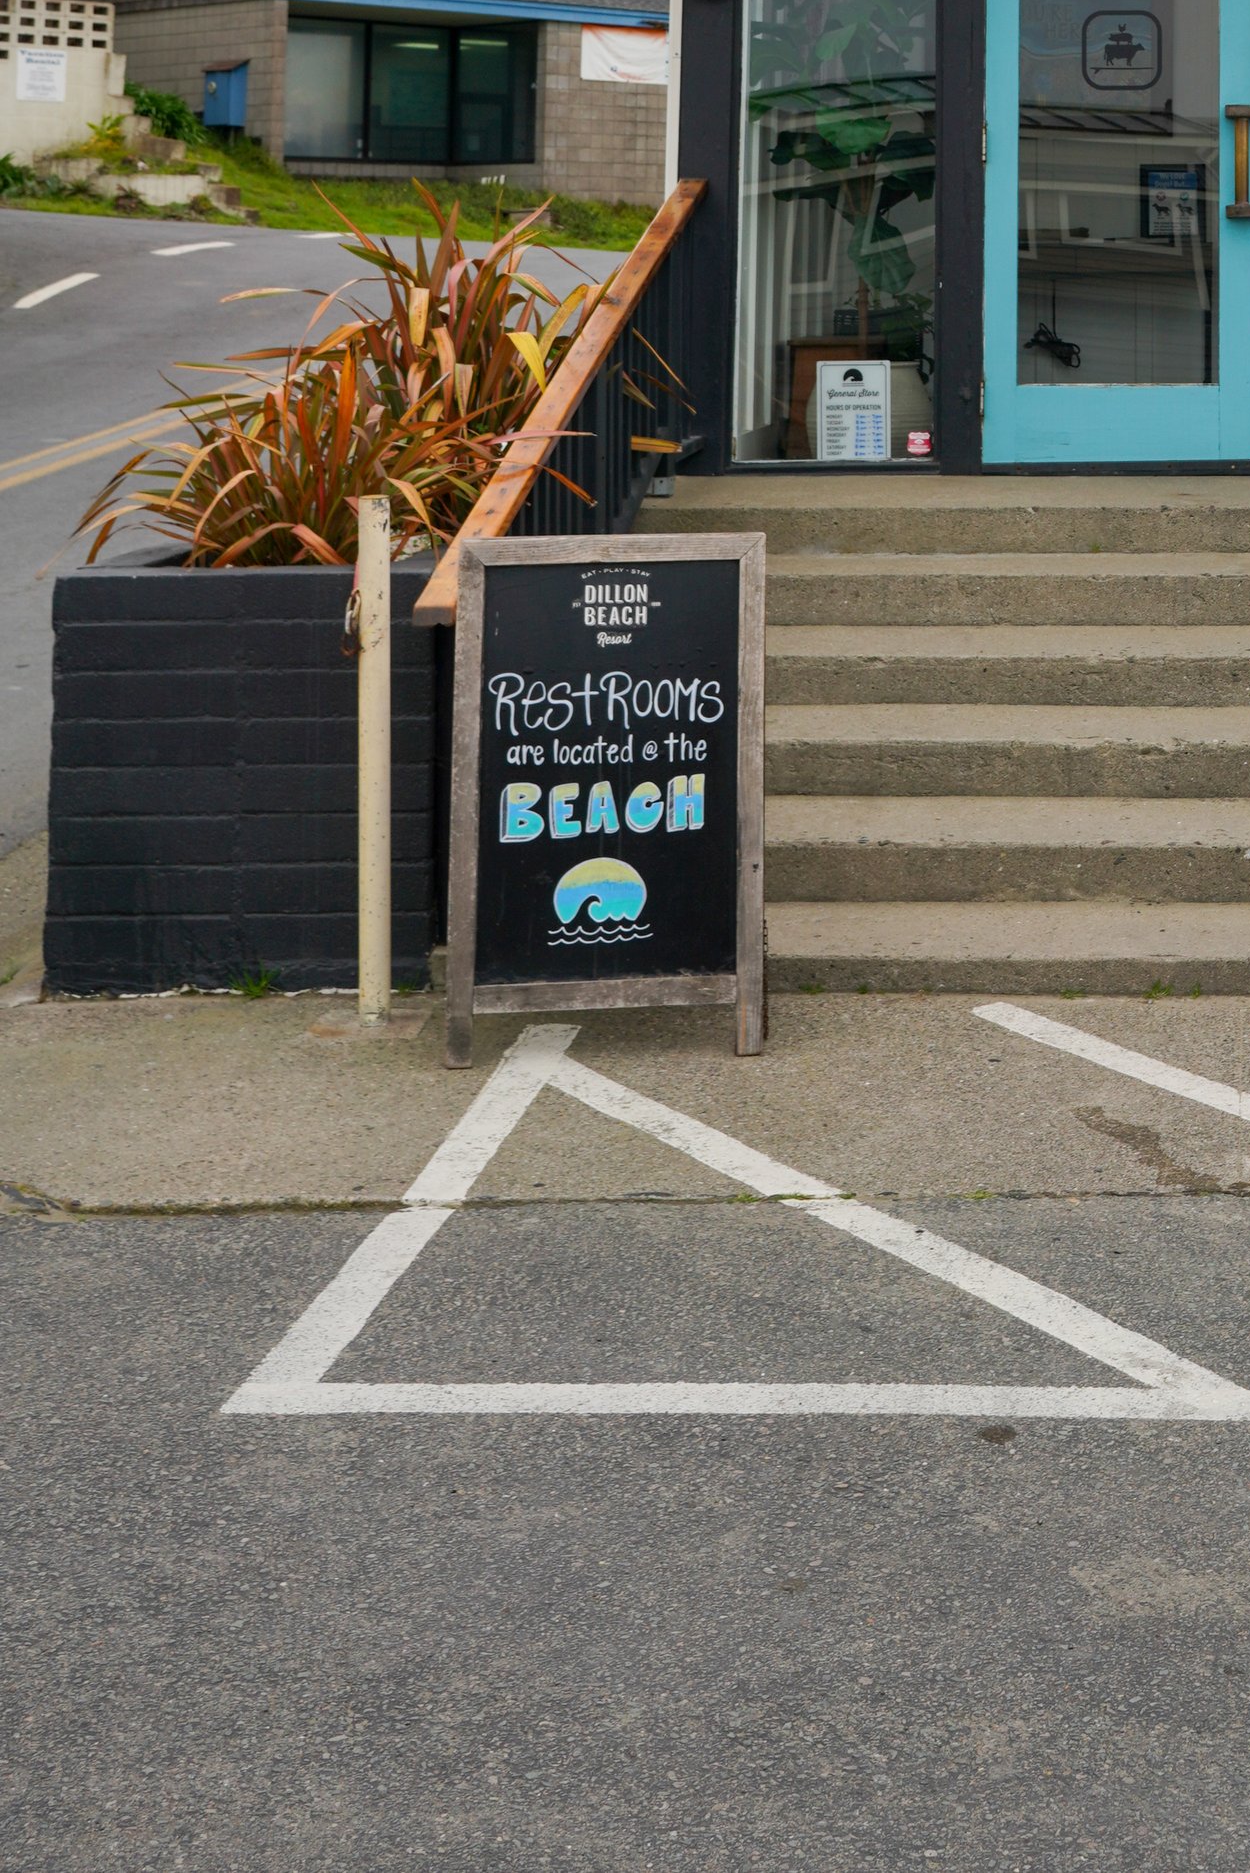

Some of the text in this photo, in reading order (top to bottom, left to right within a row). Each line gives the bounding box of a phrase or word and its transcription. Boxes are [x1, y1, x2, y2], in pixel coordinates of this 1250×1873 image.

[827, 388, 880, 399] General Store
[581, 570, 597, 579] EAT
[631, 569, 652, 578] STAY
[584, 584, 648, 604] DILLON
[584, 606, 648, 627] BEACH
[596, 631, 633, 648] Resort
[506, 732, 708, 766] are located @ the
[499, 773, 706, 844] BEACH
